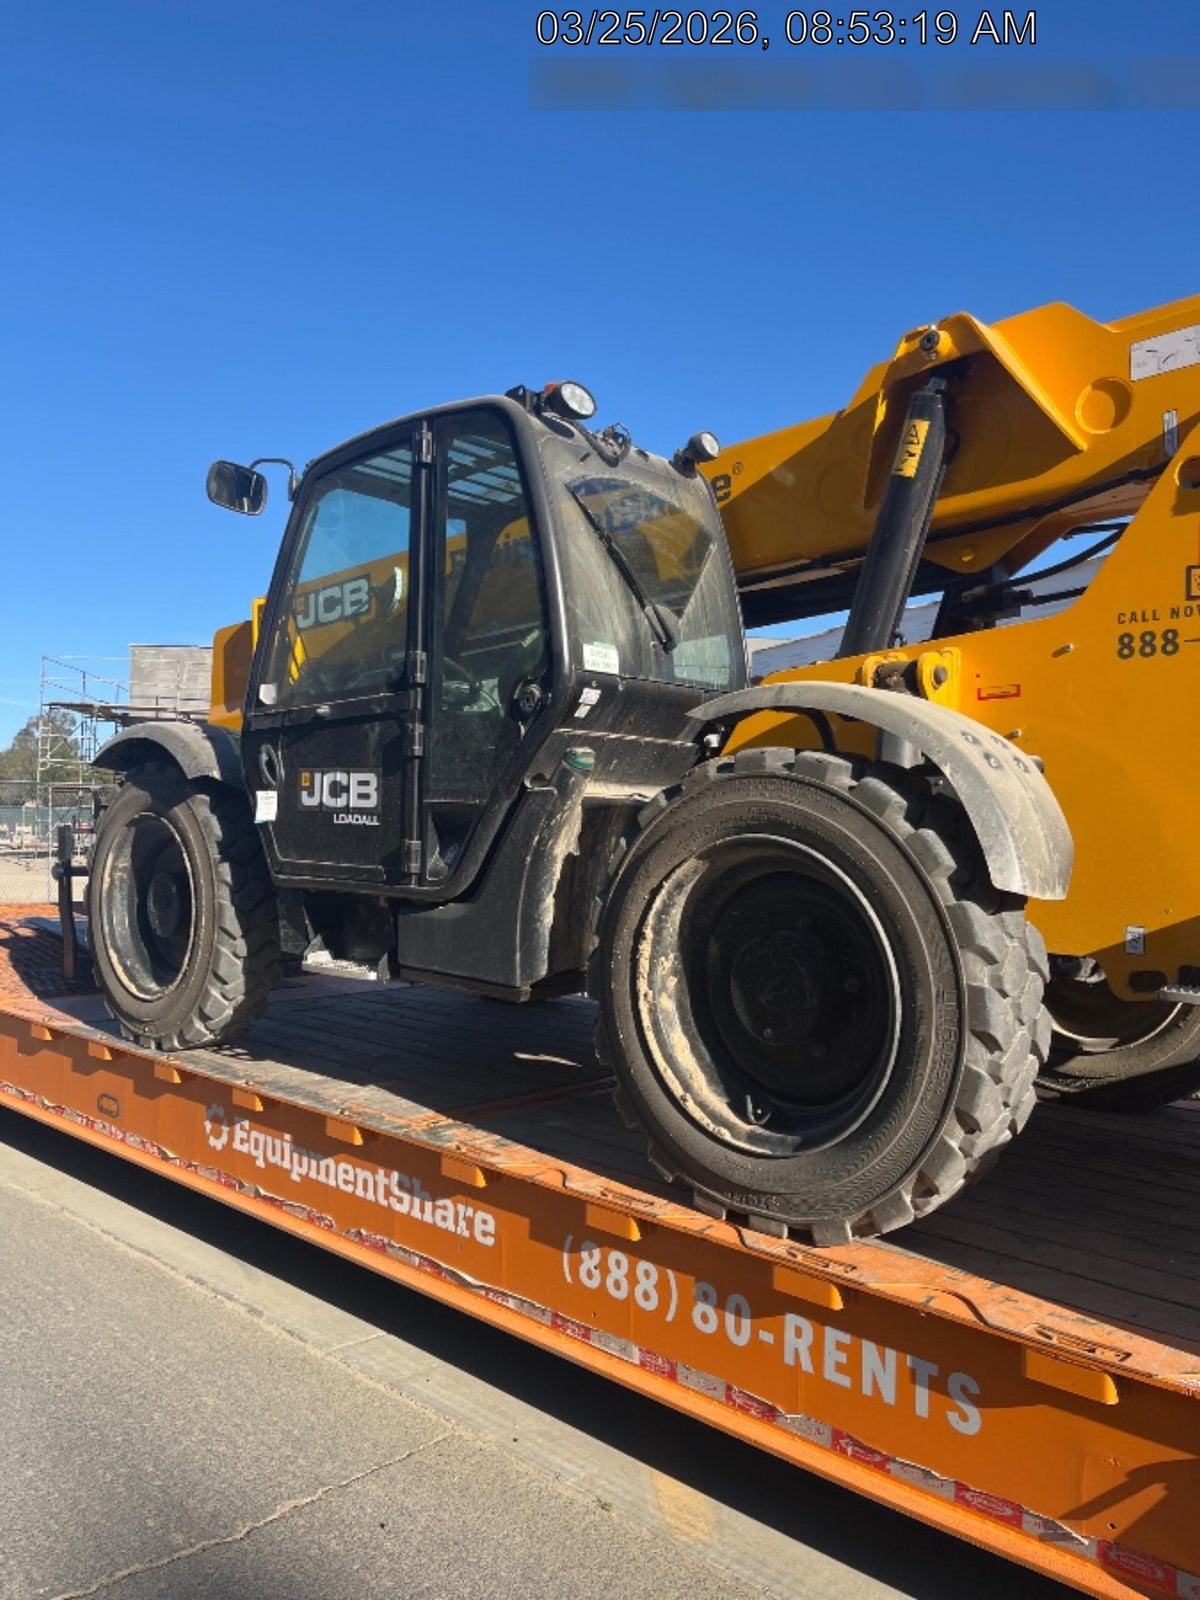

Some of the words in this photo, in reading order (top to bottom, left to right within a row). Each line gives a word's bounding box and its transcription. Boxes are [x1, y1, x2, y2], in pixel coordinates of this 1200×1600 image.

[297, 579, 369, 629] JCB
[1117, 609, 1160, 625] CALL
[301, 771, 378, 808] JCB
[333, 813, 380, 826] LOADALL
[232, 1112, 496, 1248] EquipmentShare
[563, 1235, 679, 1322] (888)
[692, 1281, 983, 1436] 80-RENTS
